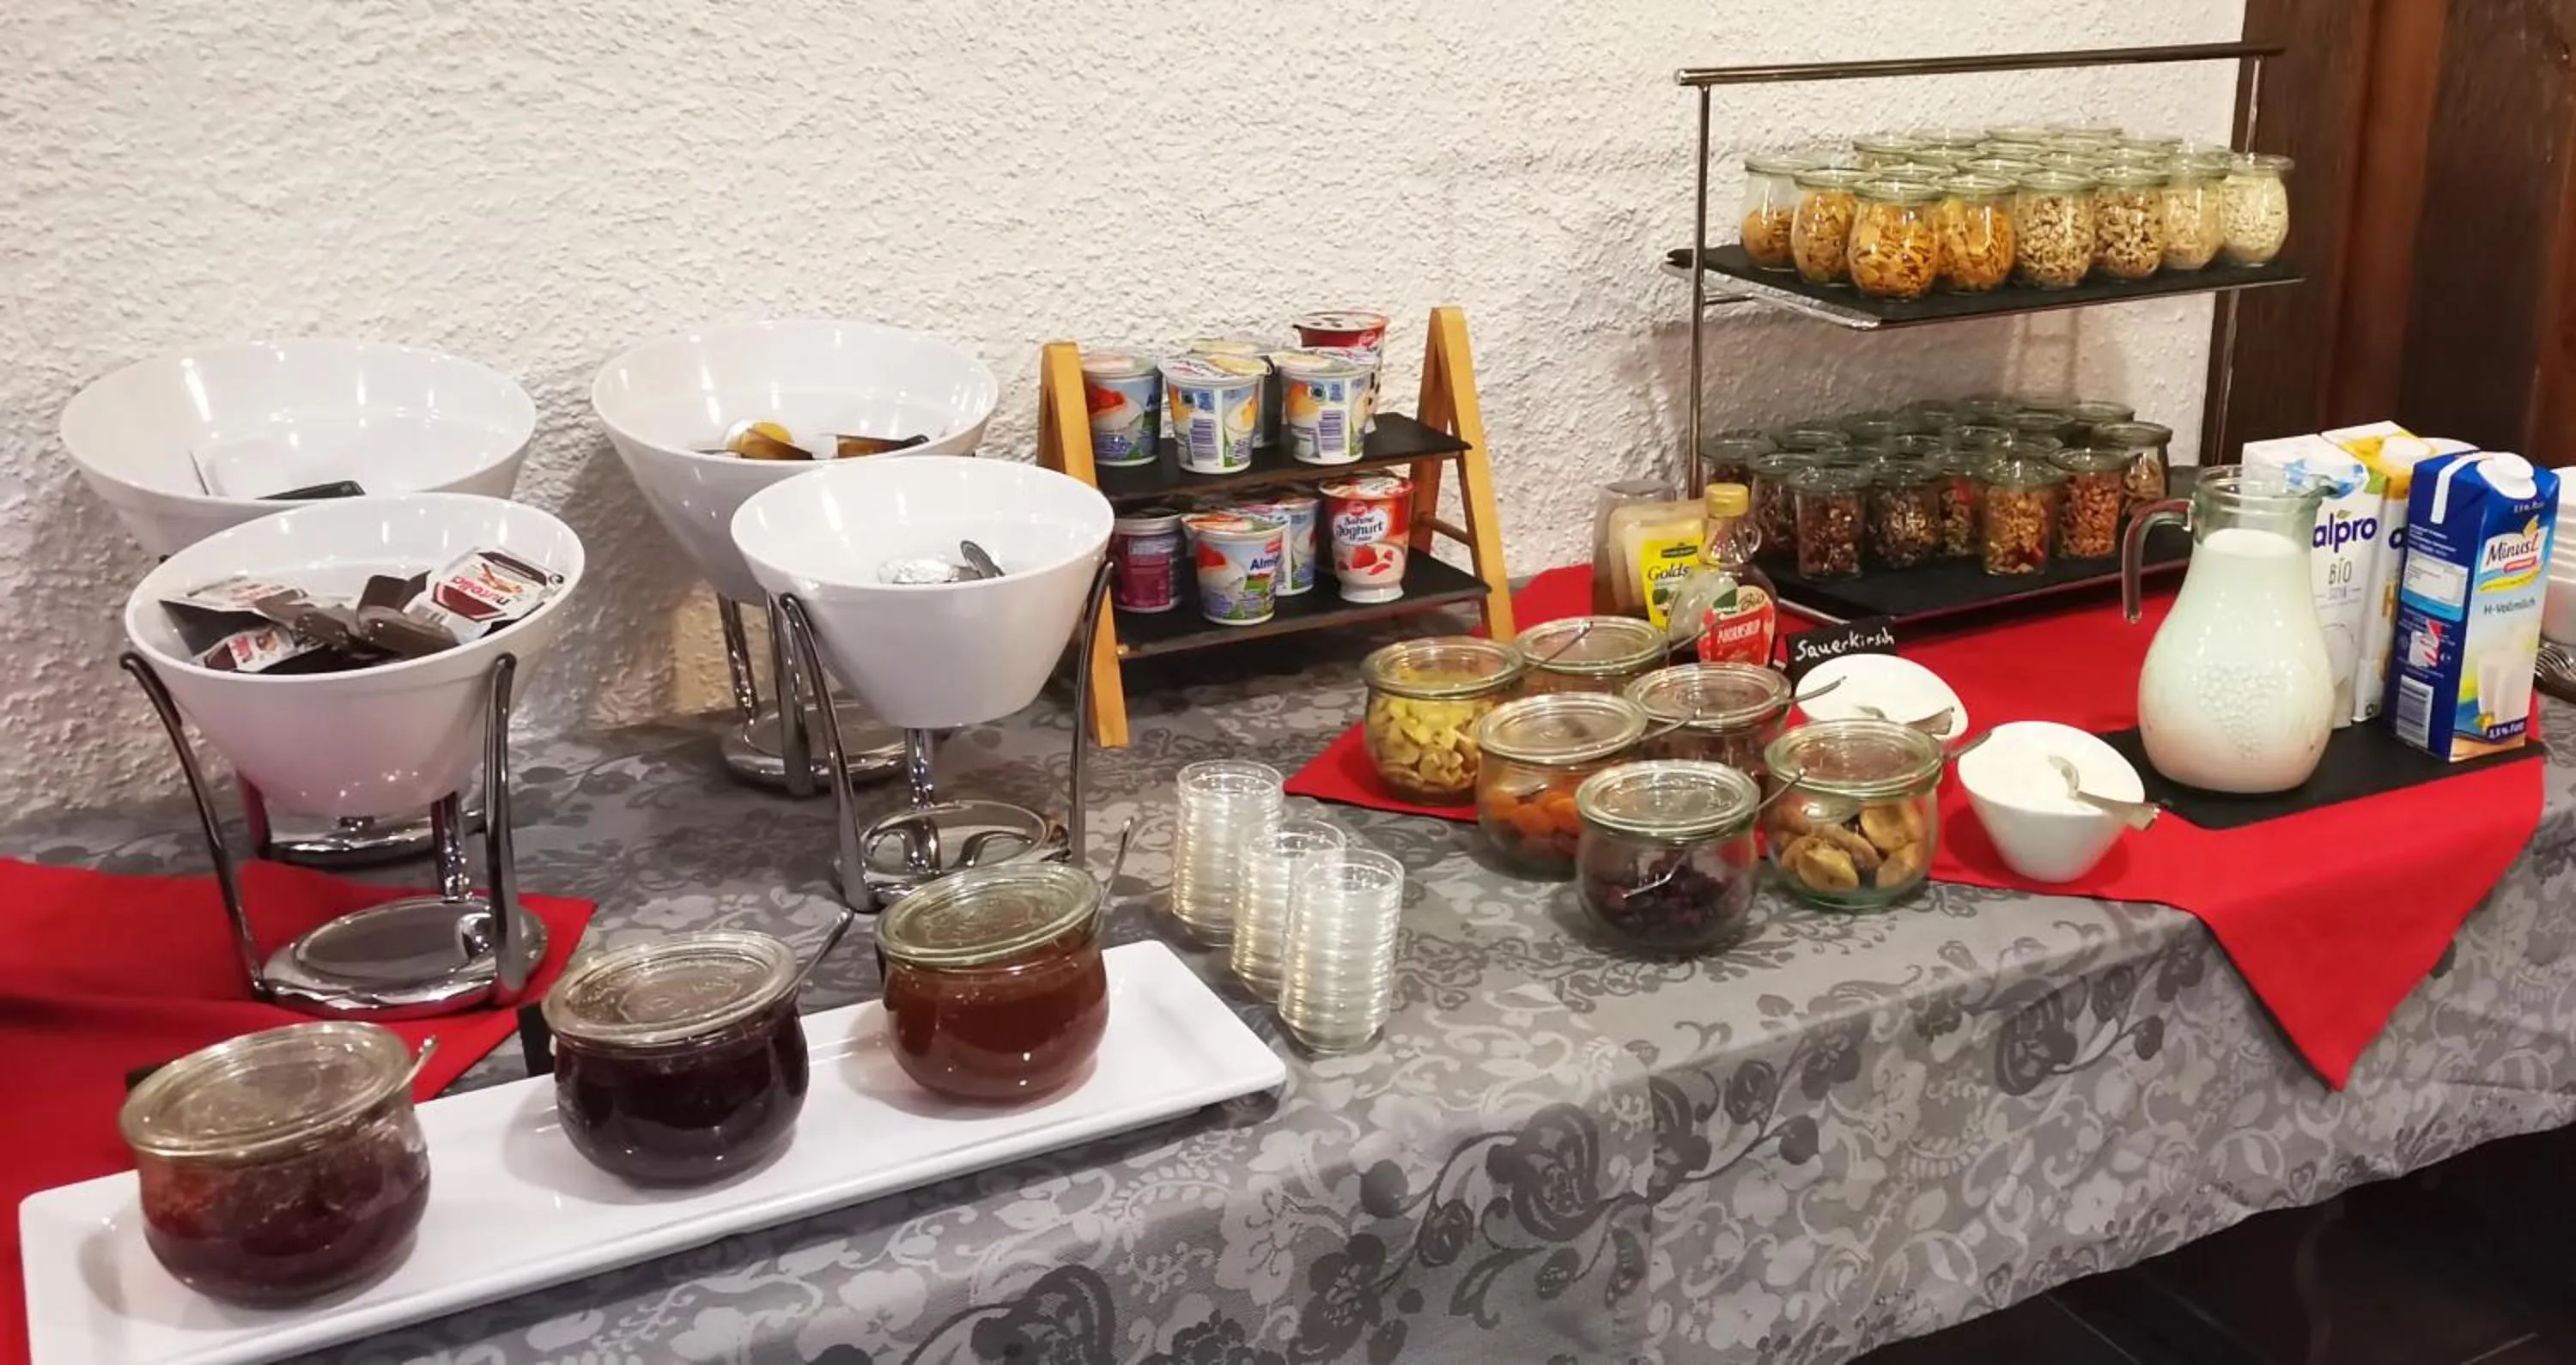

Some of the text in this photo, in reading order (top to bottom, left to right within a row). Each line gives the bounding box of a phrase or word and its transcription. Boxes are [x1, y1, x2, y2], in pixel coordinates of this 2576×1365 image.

[2312, 513, 2378, 554] alpro
[1647, 562, 1691, 581] Golds
[1795, 626, 1896, 662] Sauerkirsch
